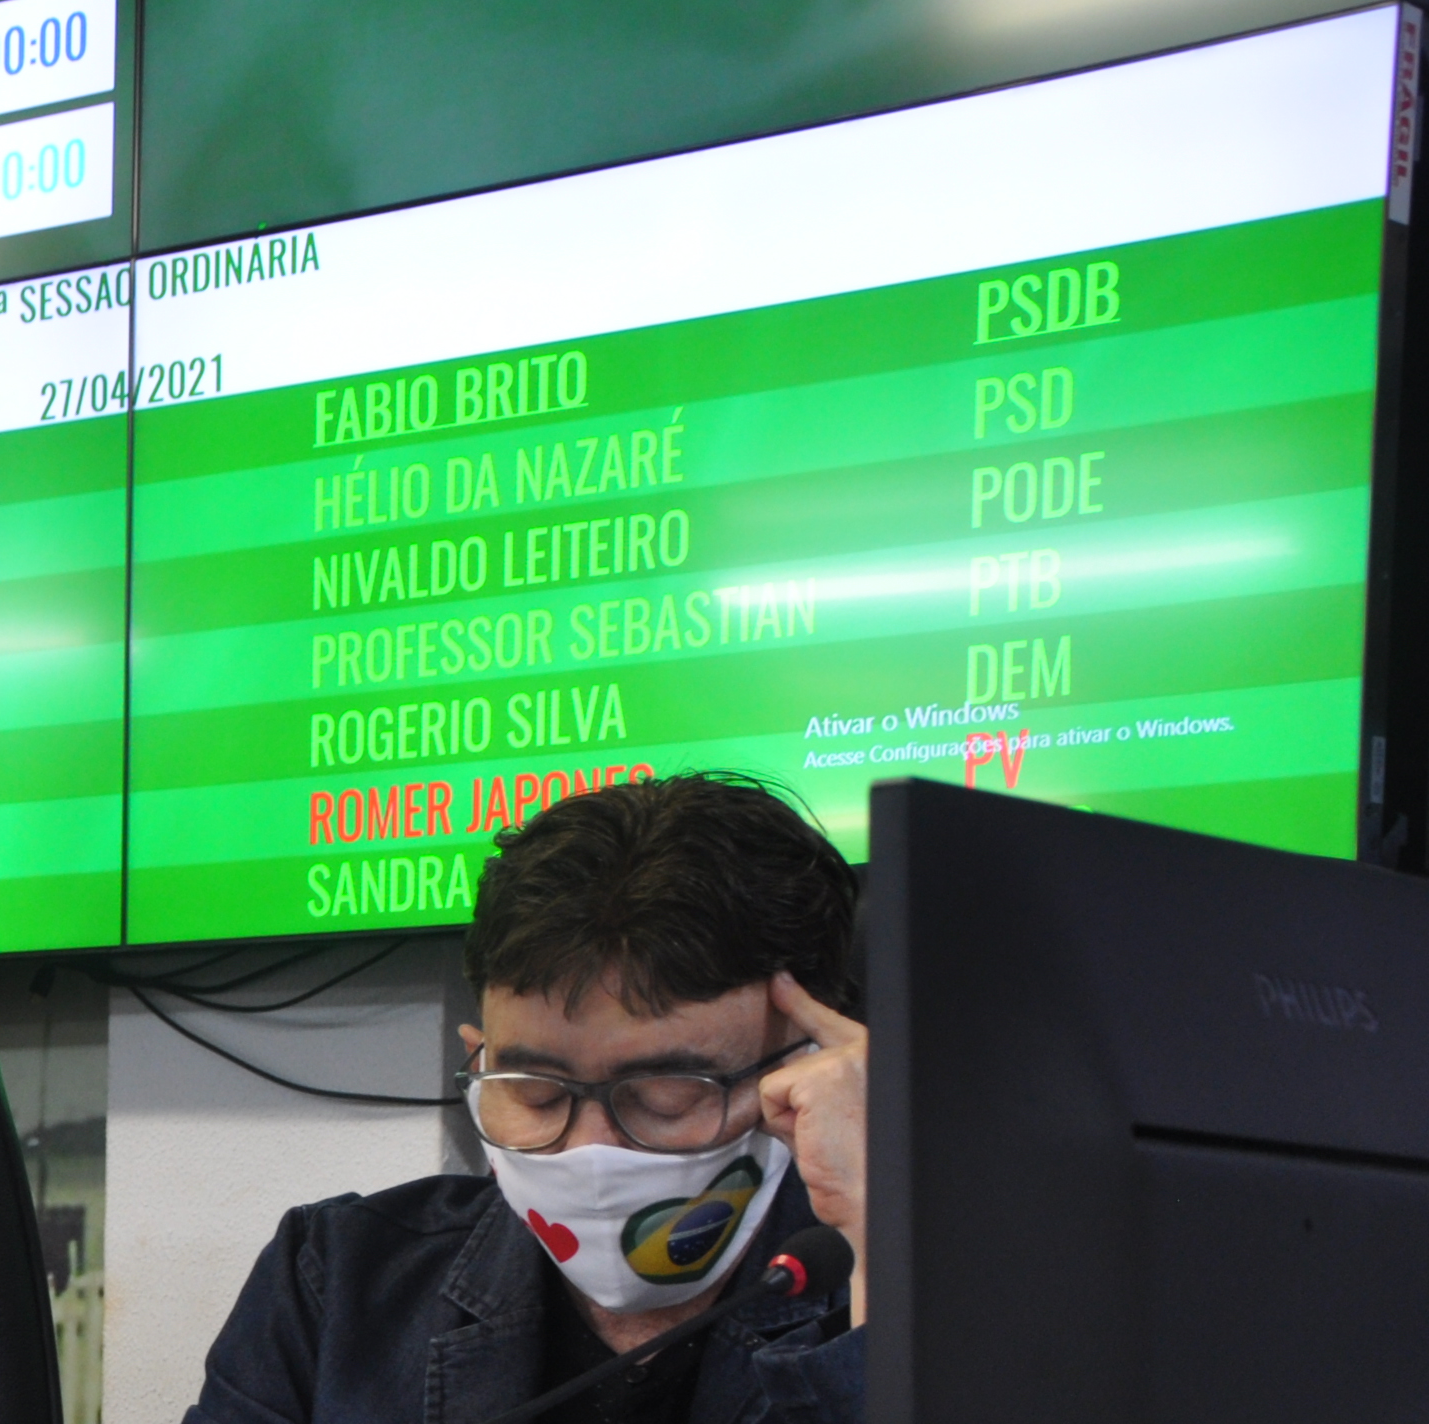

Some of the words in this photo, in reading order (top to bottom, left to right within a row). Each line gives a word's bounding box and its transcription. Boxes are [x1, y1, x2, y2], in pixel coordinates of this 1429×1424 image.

[973, 260, 1121, 345] PSDB
[40, 353, 223, 421] 27/04/2021
[312, 374, 439, 447] FABIO
[456, 350, 588, 425] BRITO
[973, 366, 1075, 440] PSD
[313, 455, 430, 533] HÉLIO
[445, 450, 500, 515] DA
[516, 407, 685, 505] NAZARÉ
[970, 451, 1106, 529] PODE
[312, 536, 488, 612] NIVALDO
[503, 508, 690, 588] LEITEIRO
[968, 547, 1062, 617] PTB
[311, 608, 554, 690] PROFESSOR
[569, 578, 818, 660] SEBASTIAN
[965, 634, 1072, 706] DEM
[309, 696, 493, 768] ROGERIO
[506, 683, 628, 749] SILVA
[803, 747, 865, 770] Acesse
[869, 734, 1003, 764] Configurações
[1009, 731, 1052, 755] para
[1056, 725, 1113, 748] ativar
[1116, 726, 1132, 743] o
[1135, 714, 1235, 740] Windows.
[804, 713, 875, 740] Ativar
[881, 713, 899, 732] o
[905, 701, 1020, 730] Windows
[964, 728, 1030, 790] PV
[309, 781, 453, 846] ROMER
[307, 852, 473, 918] SANDRA
